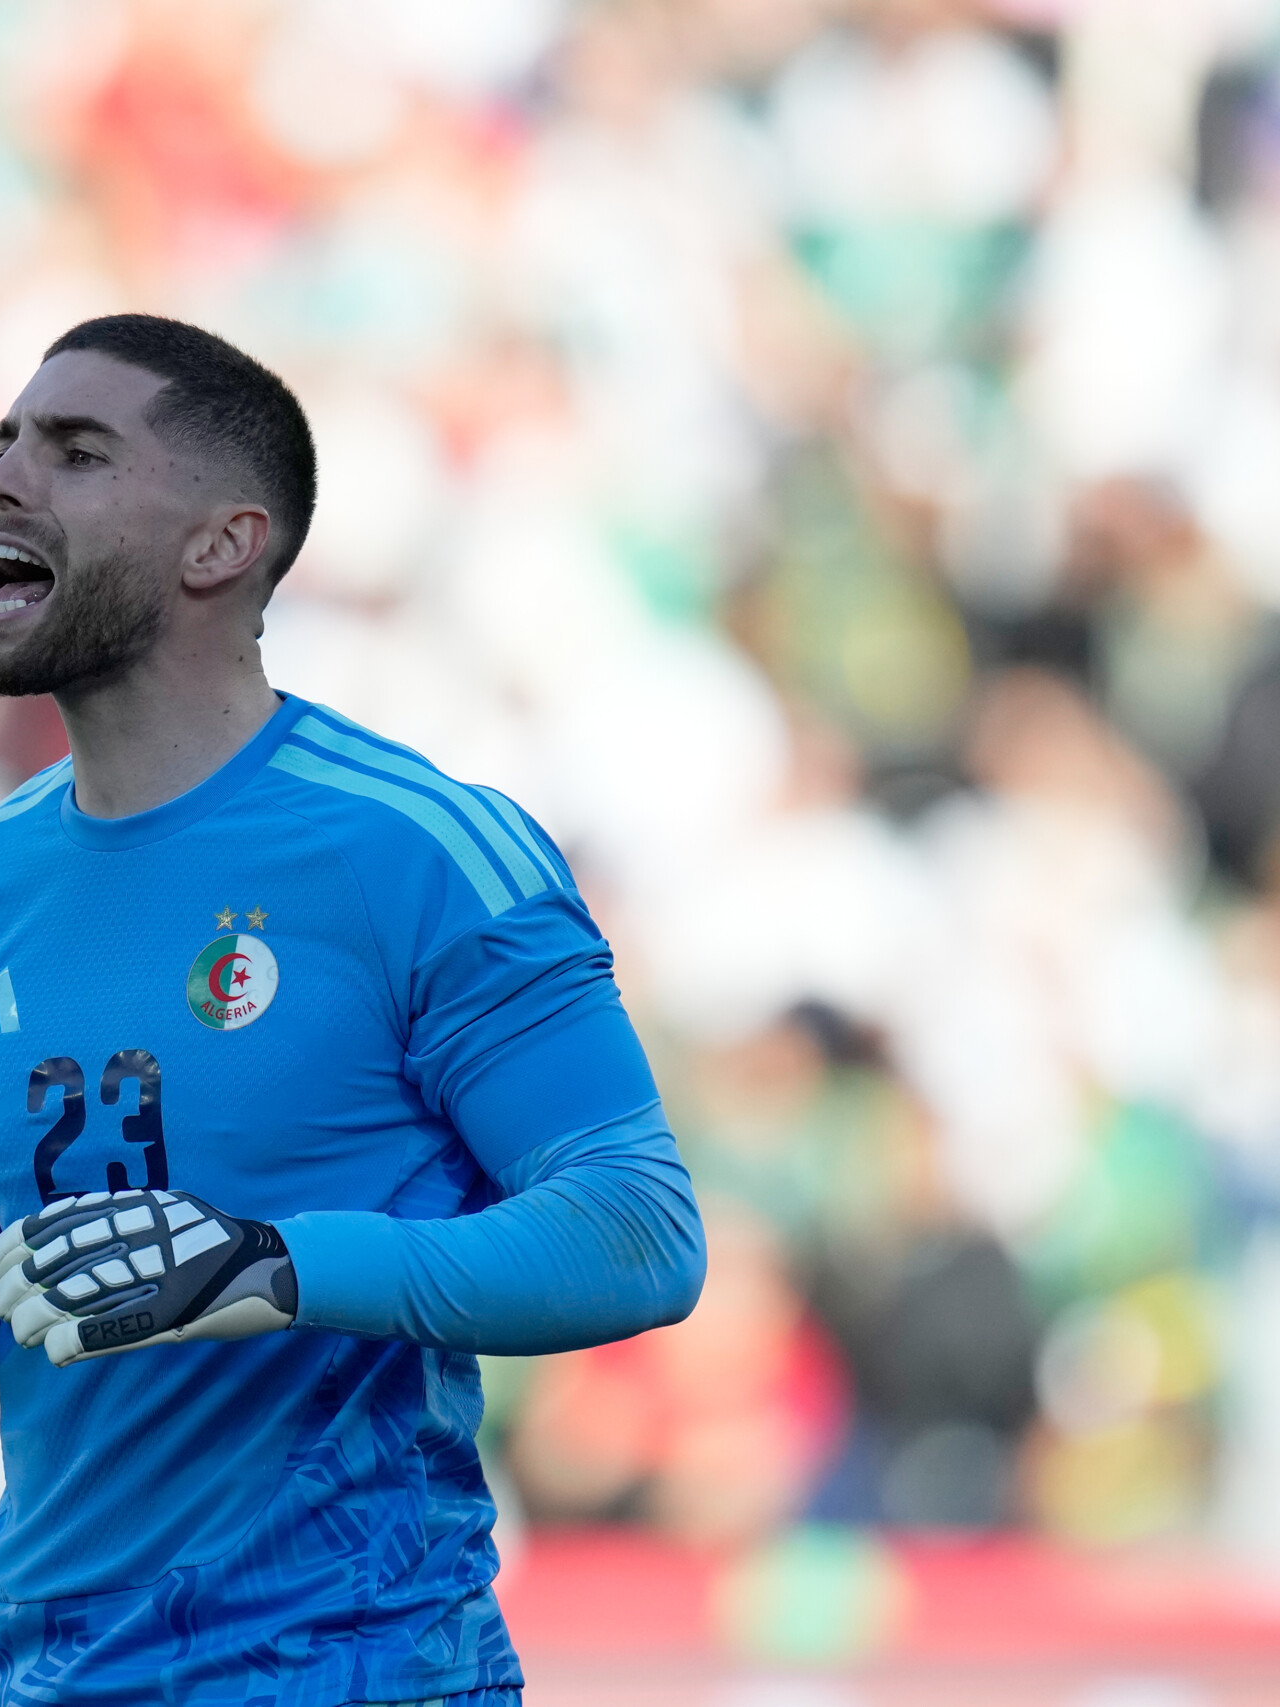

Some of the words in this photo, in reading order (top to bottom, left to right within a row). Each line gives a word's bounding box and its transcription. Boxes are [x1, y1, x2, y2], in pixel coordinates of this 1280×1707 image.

[200, 1000, 258, 1020] ALGERIA
[26, 1048, 169, 1206] 23
[81, 1311, 154, 1343] PRED
